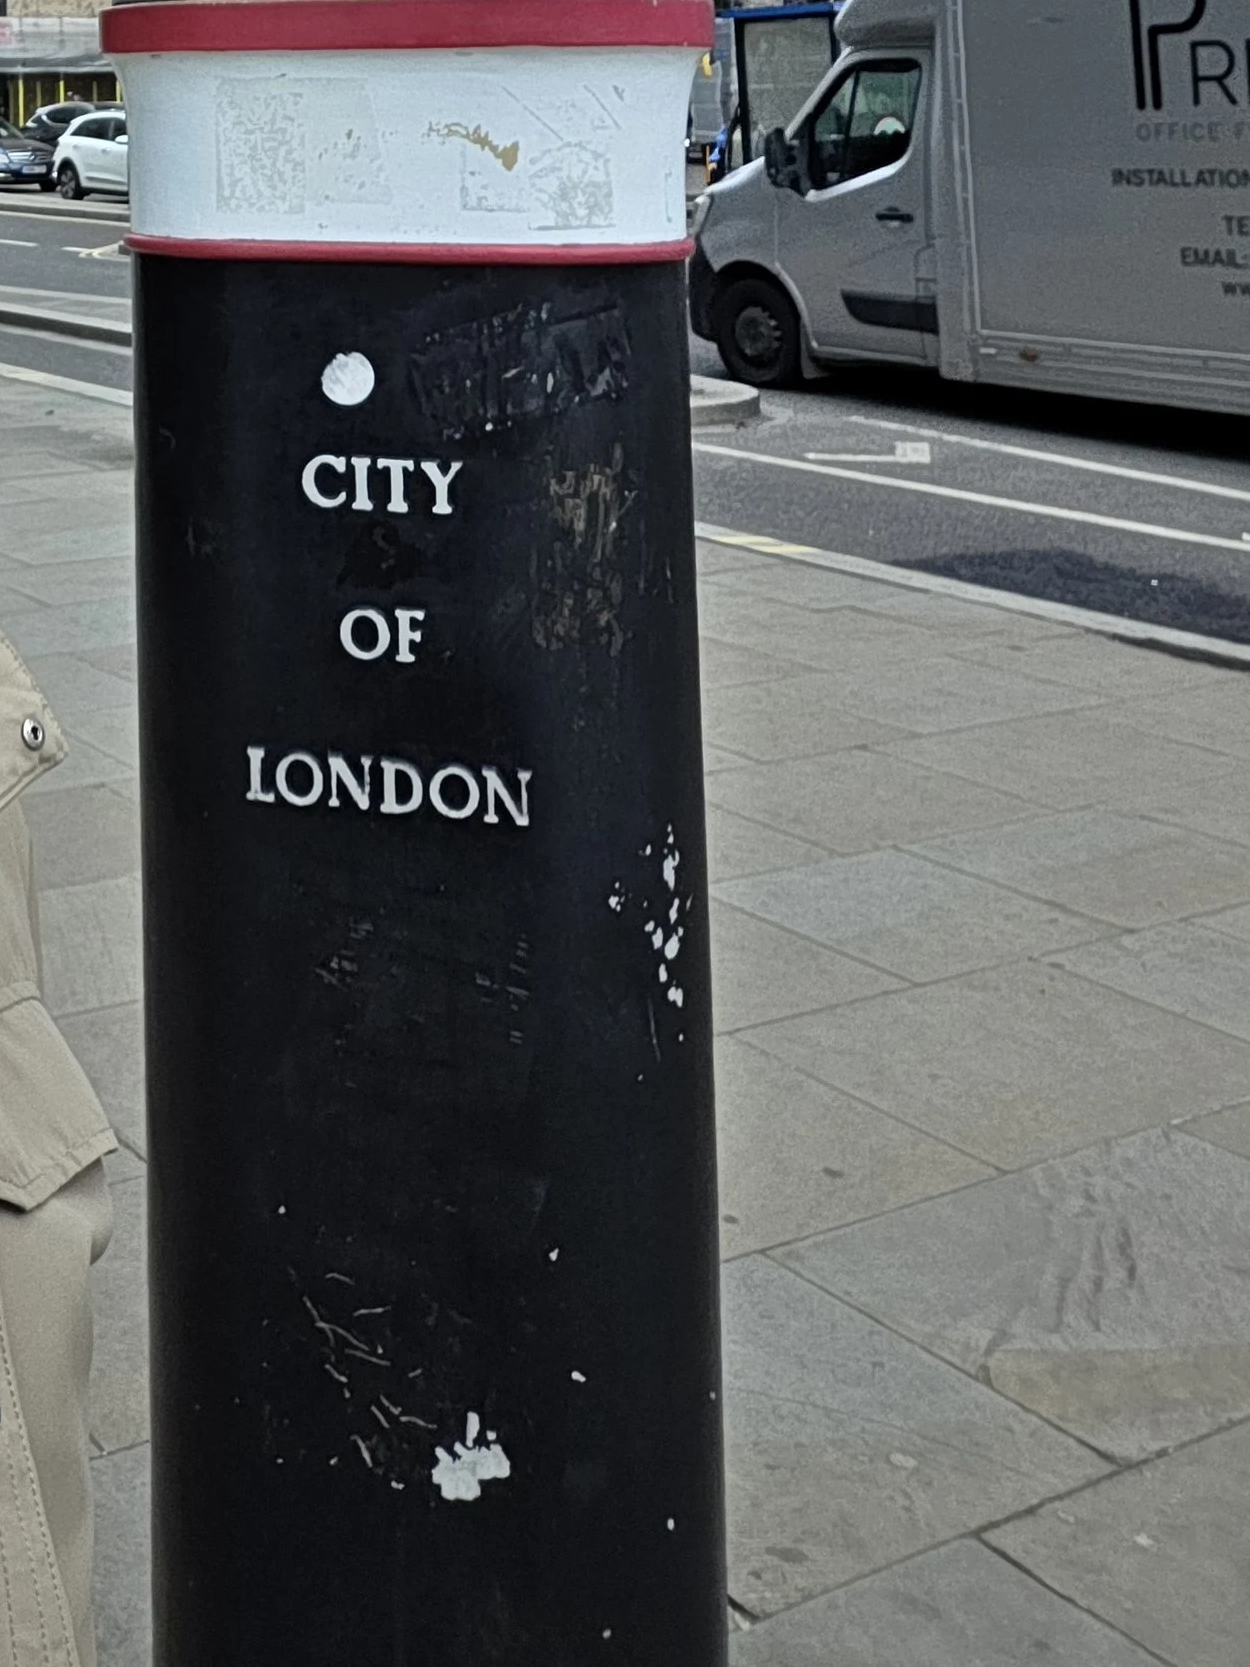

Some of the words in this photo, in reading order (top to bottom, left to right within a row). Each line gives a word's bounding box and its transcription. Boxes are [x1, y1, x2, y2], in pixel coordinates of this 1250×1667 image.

[1135, 120, 1223, 143] OFFICE
[302, 455, 462, 515] CITY
[340, 609, 425, 663] OF
[246, 746, 532, 827] LONDON
